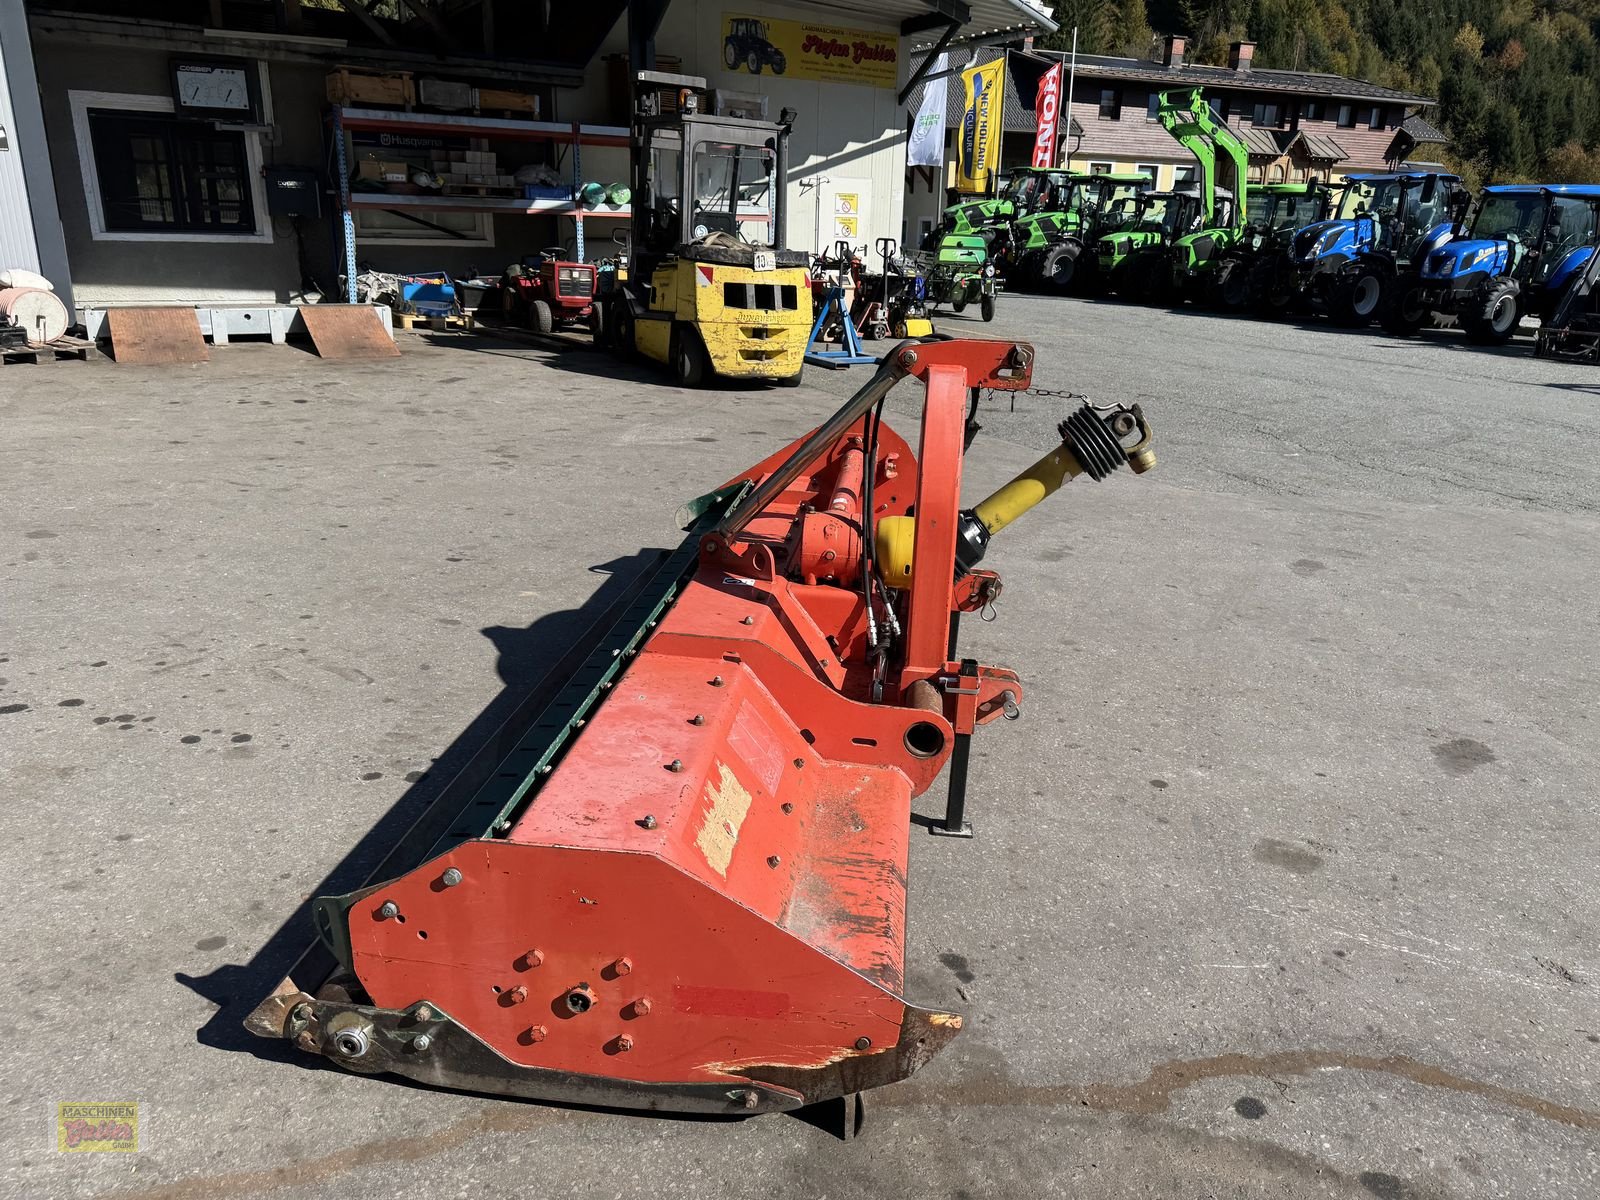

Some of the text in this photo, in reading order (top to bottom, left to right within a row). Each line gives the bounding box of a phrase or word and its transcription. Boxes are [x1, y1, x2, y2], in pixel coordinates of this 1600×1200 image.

[391, 135, 443, 148] Husqvarna
[976, 92, 989, 170] NEW HOLLAND
